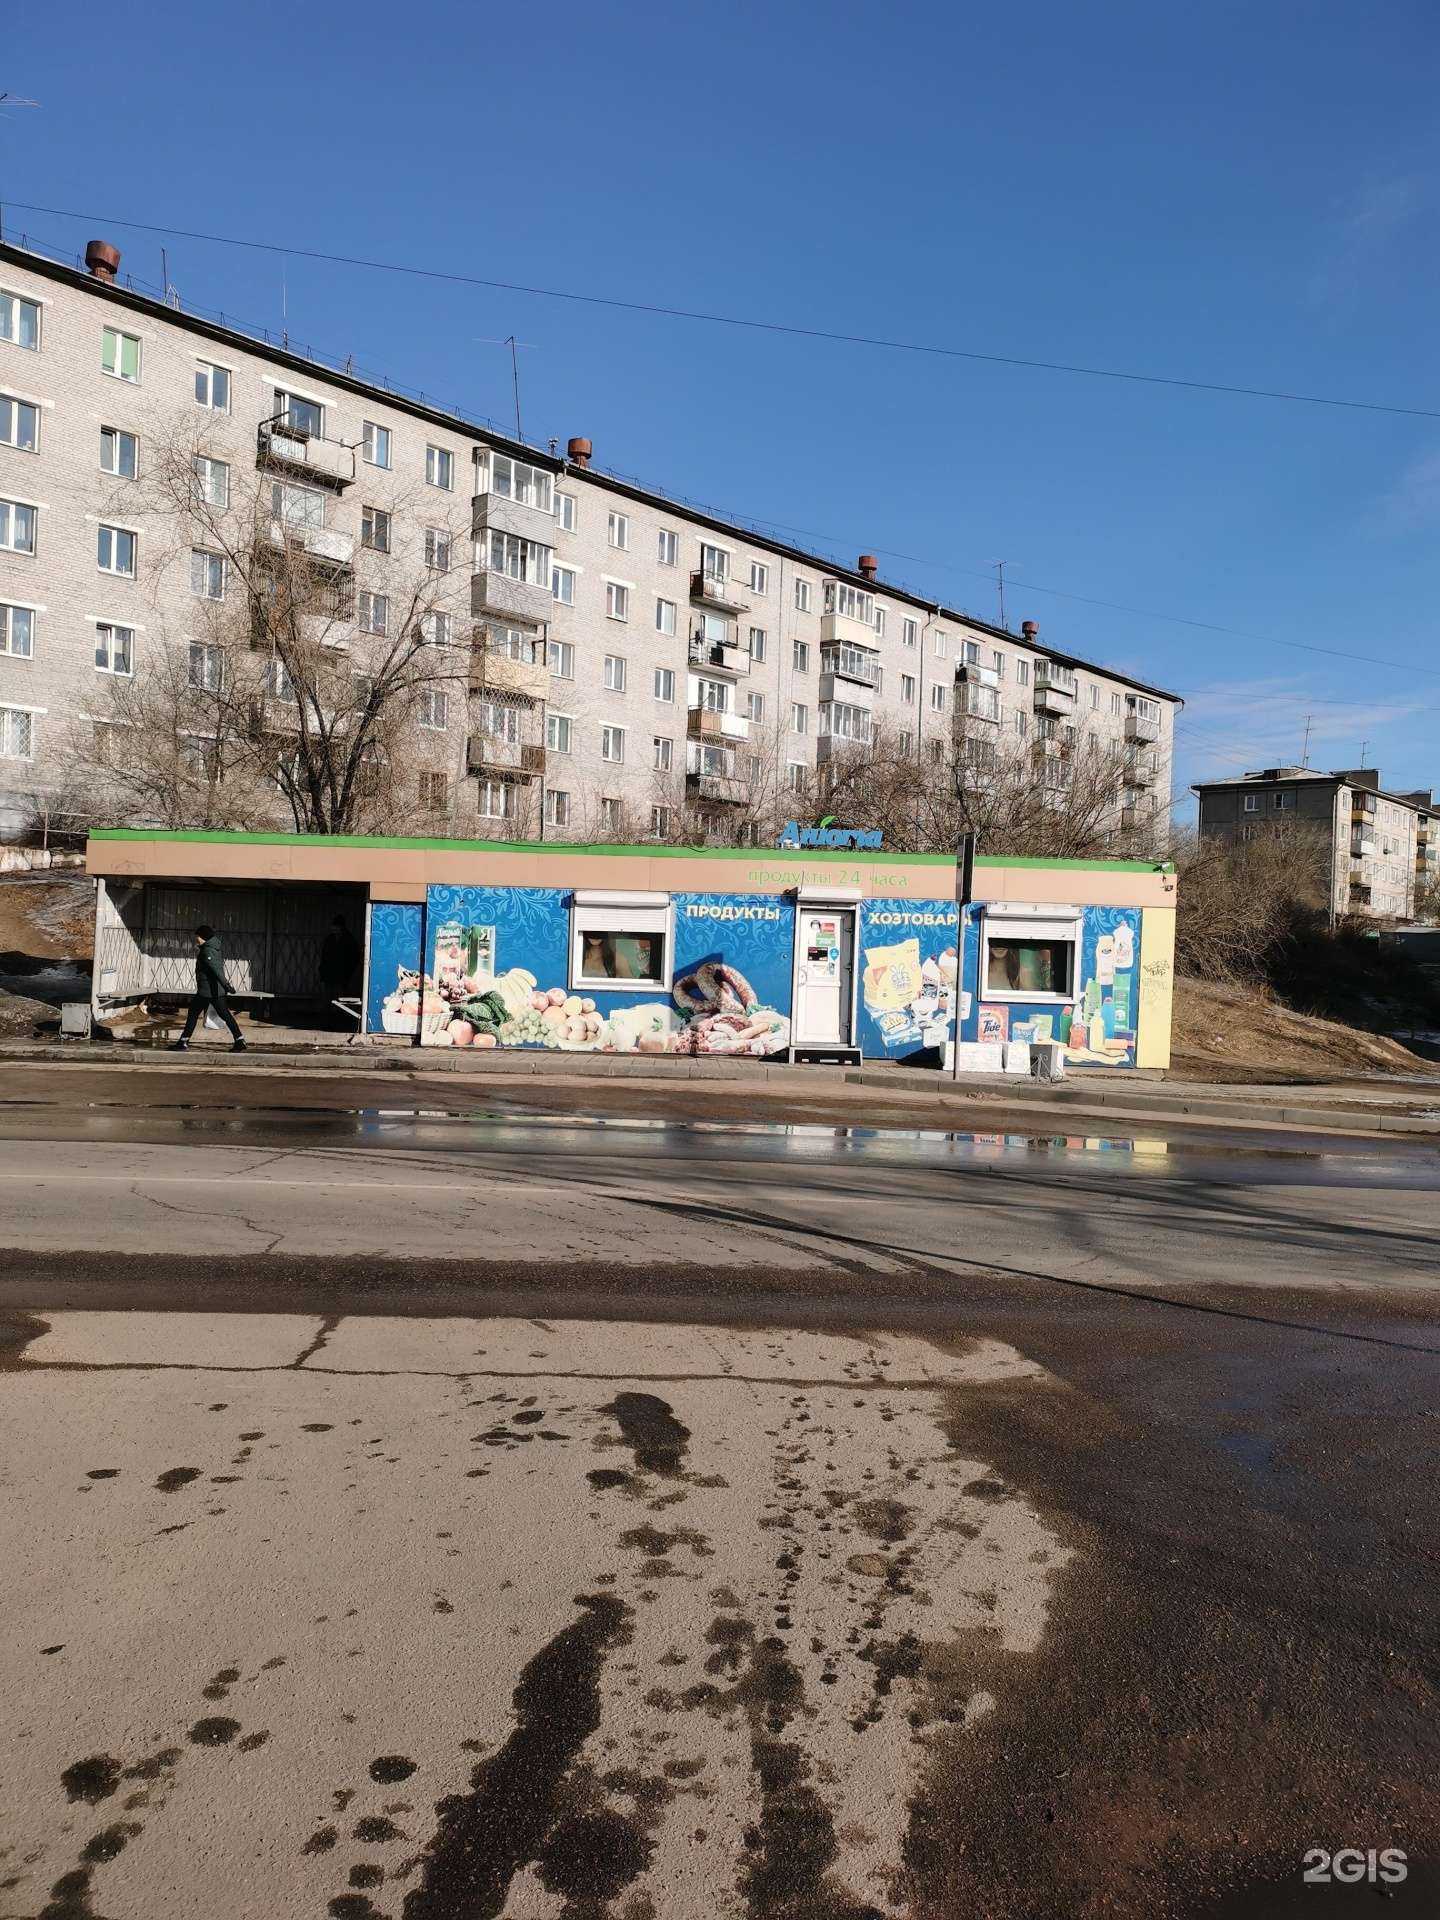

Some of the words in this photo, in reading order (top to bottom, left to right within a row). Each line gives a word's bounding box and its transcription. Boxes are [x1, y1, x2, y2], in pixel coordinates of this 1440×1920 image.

[748, 870, 831, 886] продукты
[838, 869, 862, 885] 24
[869, 872, 908, 887] часа
[686, 904, 780, 920] ПРОДУКТЫ
[983, 1019, 1001, 1034] Tide
